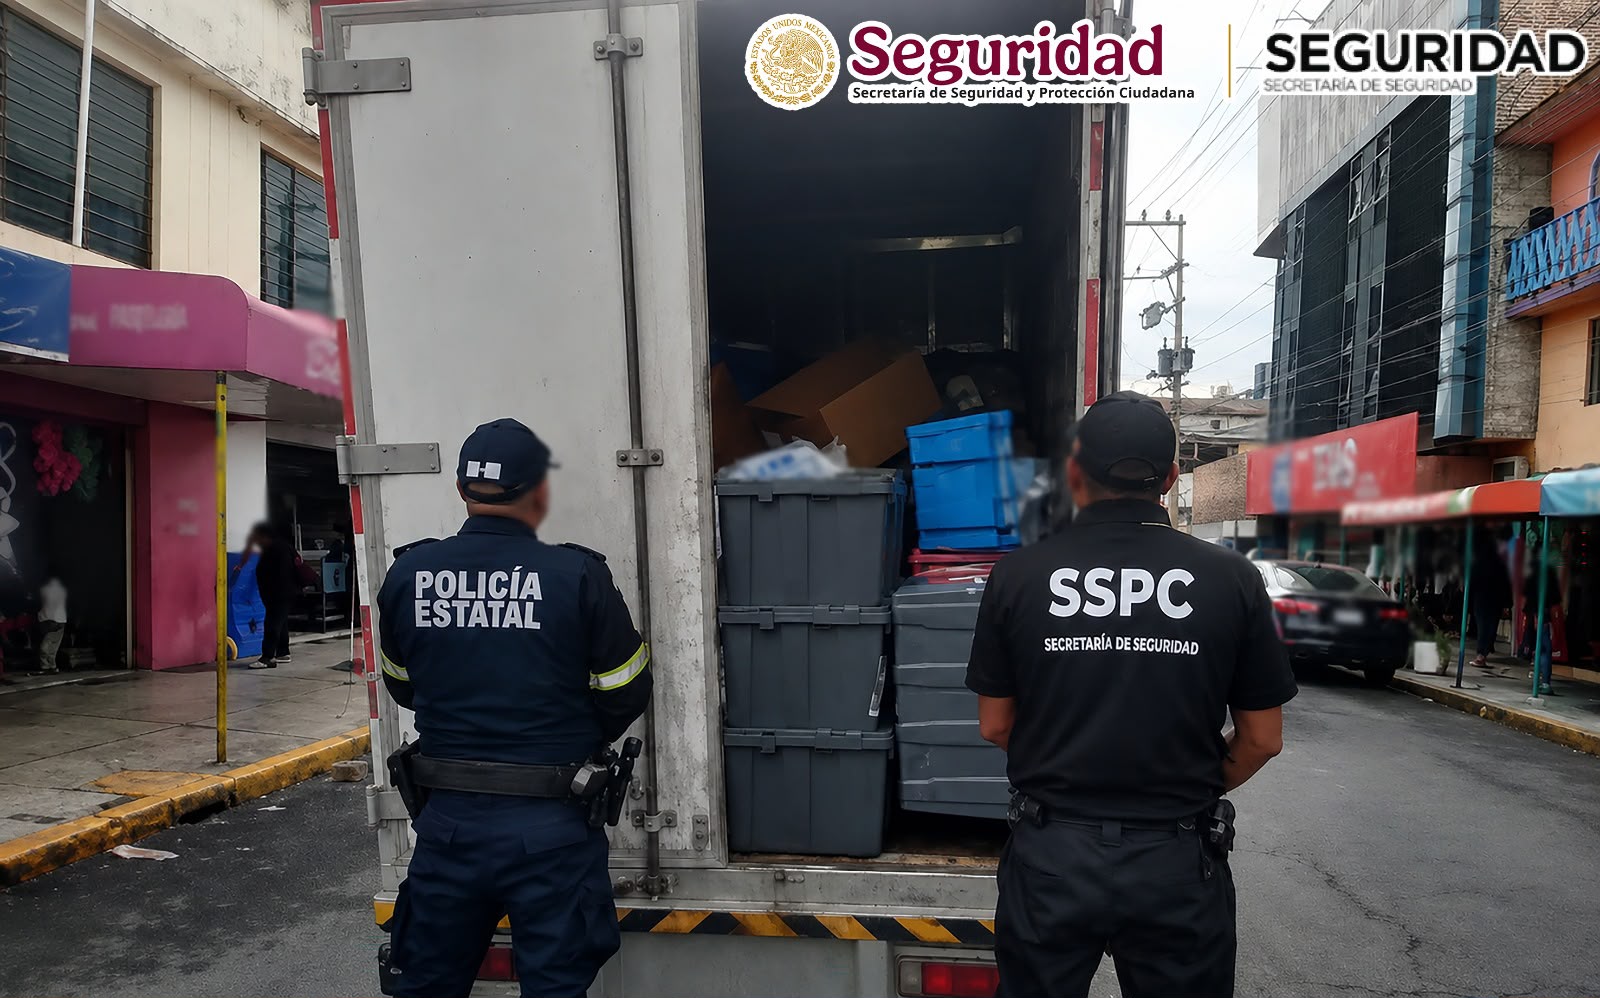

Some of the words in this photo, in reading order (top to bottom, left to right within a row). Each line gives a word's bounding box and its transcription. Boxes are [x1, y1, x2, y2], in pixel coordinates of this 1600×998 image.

[414, 565, 543, 601] POLICÍA
[1048, 567, 1196, 620] SSPC
[414, 599, 541, 630] ESTATAL
[1044, 633, 1113, 652] SECRETARÍA
[1115, 636, 1131, 651] DE
[1133, 637, 1199, 656] SEGURIDAD
